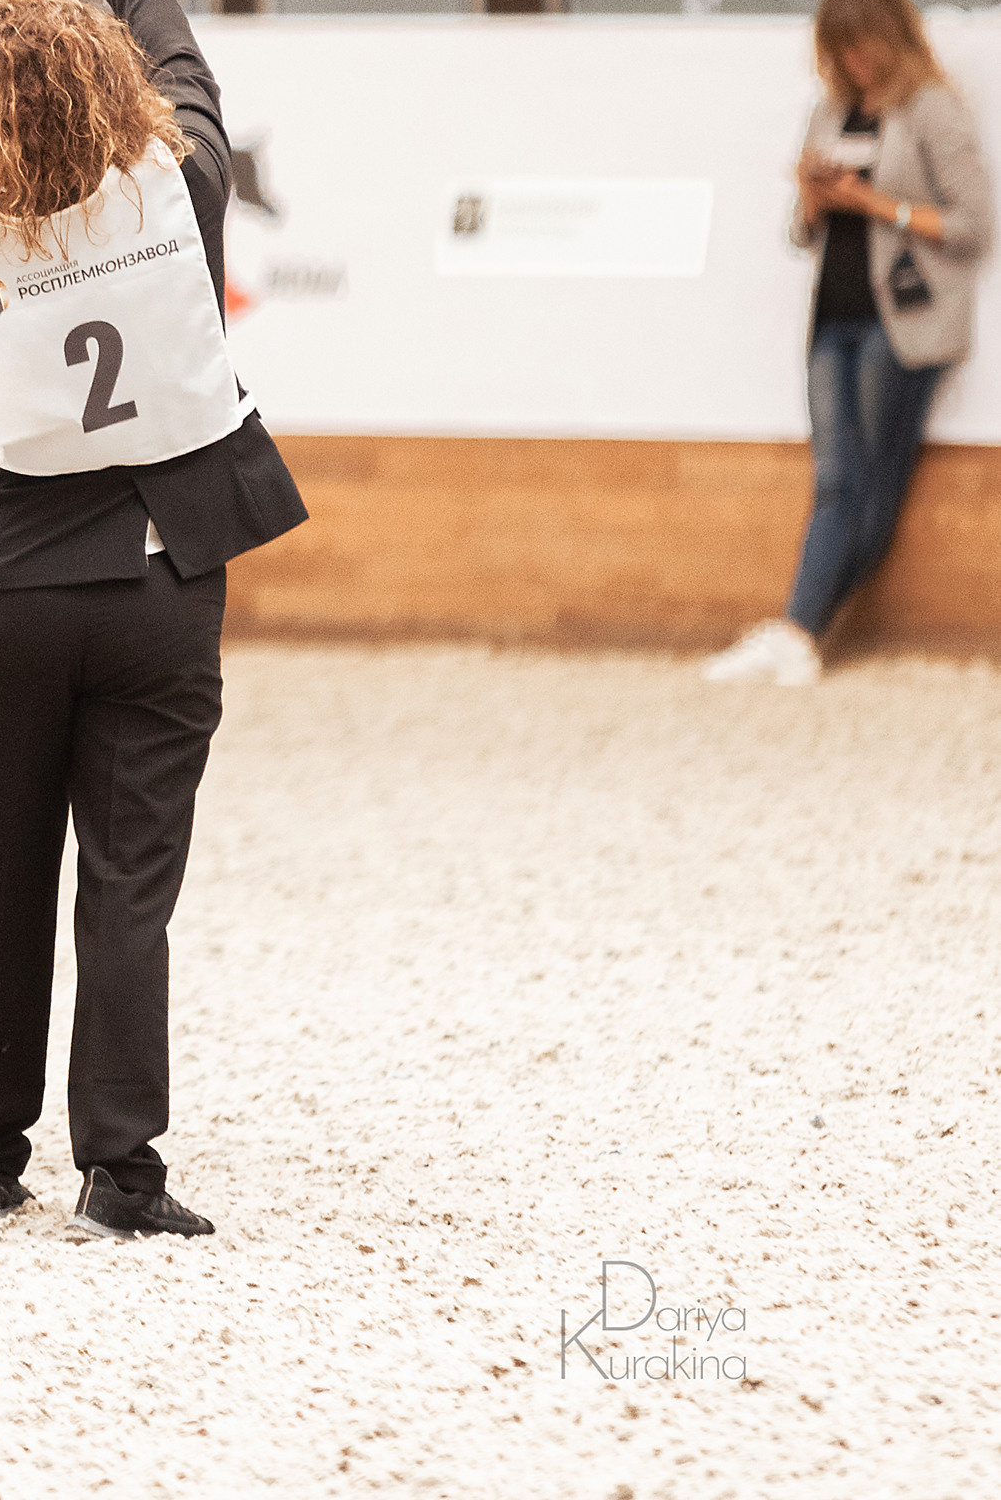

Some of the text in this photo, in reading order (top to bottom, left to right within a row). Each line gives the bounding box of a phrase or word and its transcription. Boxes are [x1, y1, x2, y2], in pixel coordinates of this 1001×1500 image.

[16, 260, 79, 284] АССОЦИАЦИЯ
[18, 239, 180, 300] РОСПЛЕМКОНЗАВОД
[63, 320, 139, 434] 2
